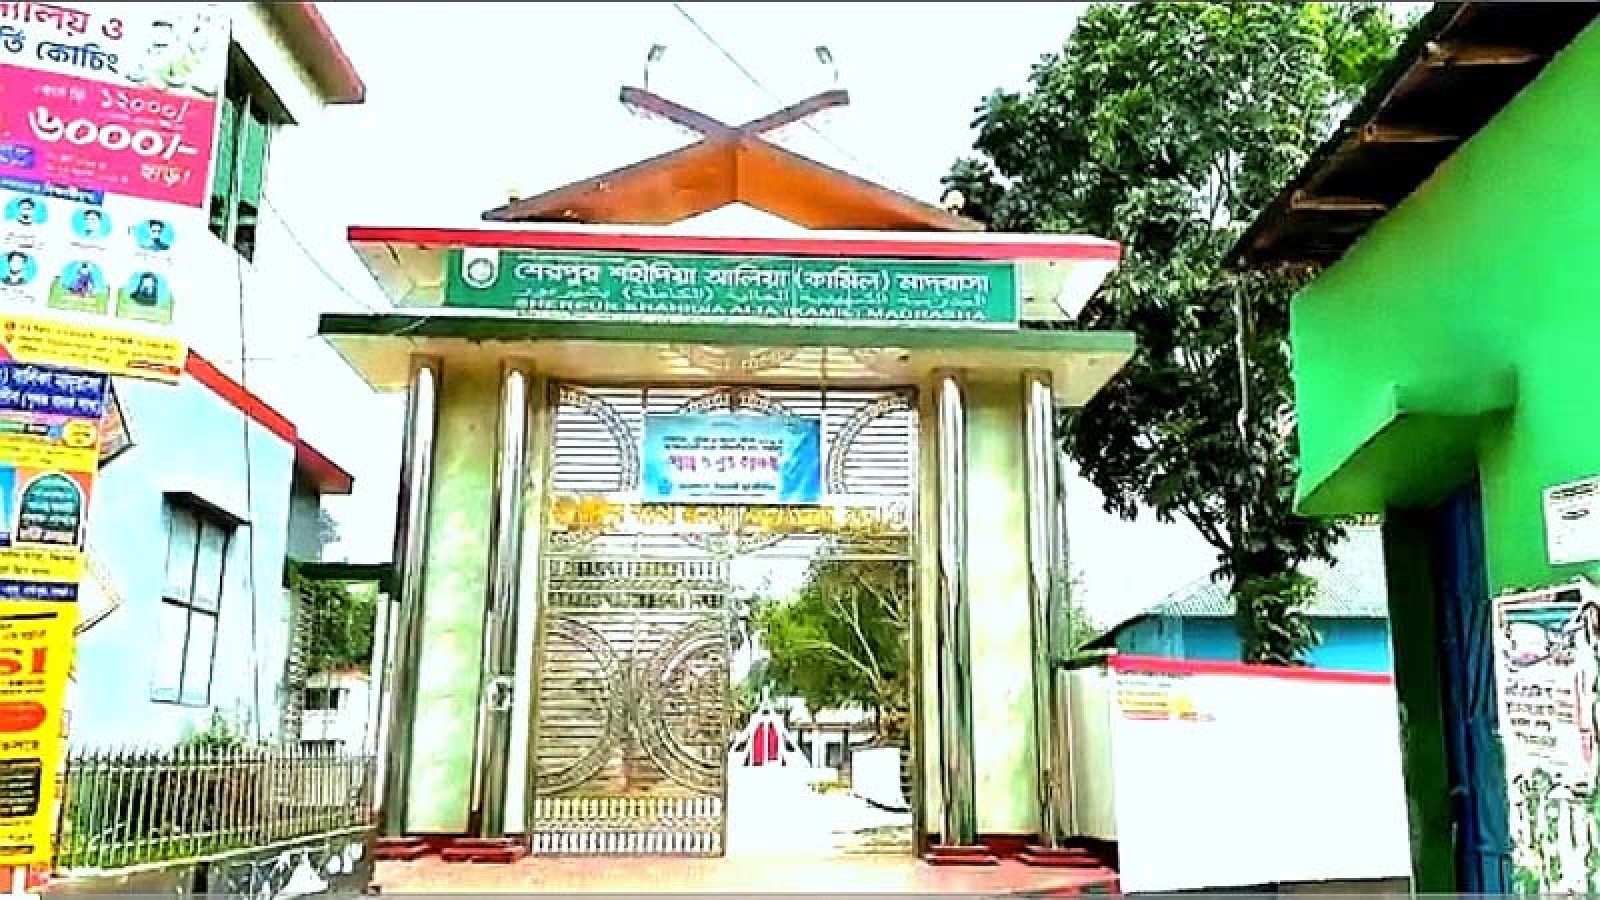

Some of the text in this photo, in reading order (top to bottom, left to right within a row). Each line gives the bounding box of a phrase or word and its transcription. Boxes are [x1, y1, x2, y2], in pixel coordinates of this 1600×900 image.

[101, 18, 123, 40] ও
[37, 41, 118, 74] কোচিং
[28, 105, 198, 160] ৬০০০/-
[514, 263, 601, 285] শেরপুর
[703, 264, 791, 288] আলিয়া
[795, 265, 891, 292] (কামিল)
